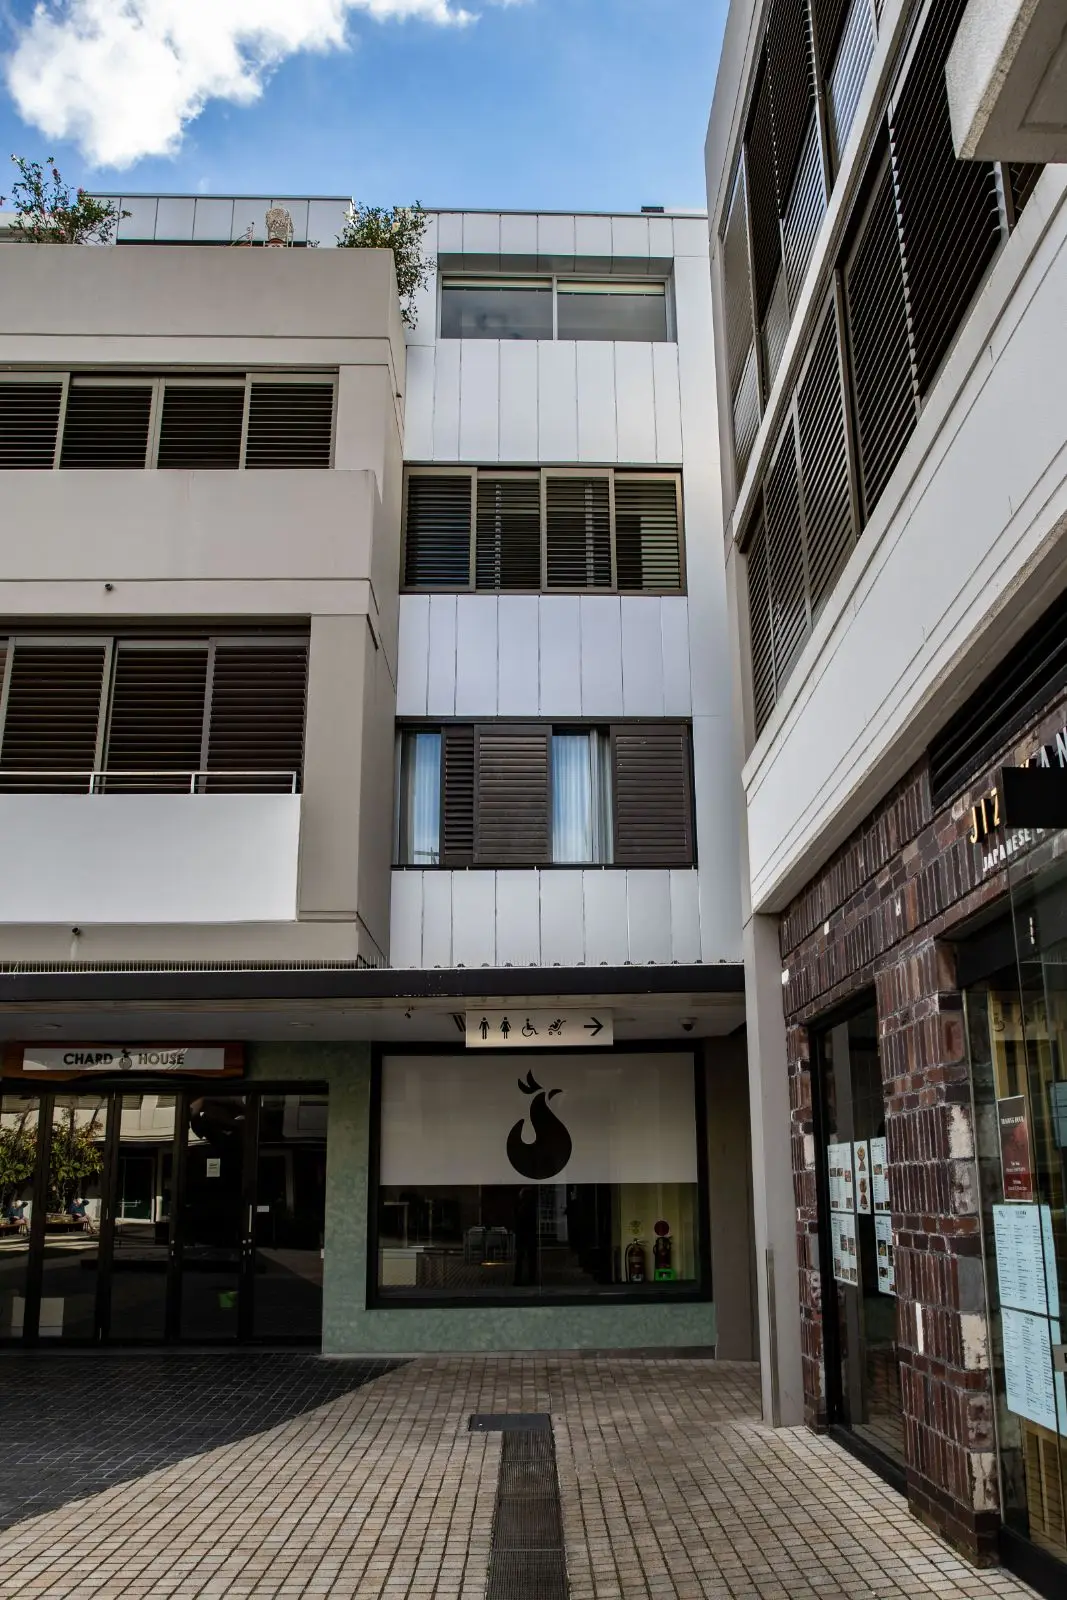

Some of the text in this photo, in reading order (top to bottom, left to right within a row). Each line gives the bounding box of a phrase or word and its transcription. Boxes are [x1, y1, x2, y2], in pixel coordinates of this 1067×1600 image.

[982, 827, 1032, 873] JAPANESE
[63, 1052, 185, 1065] CHARD HOUSE
